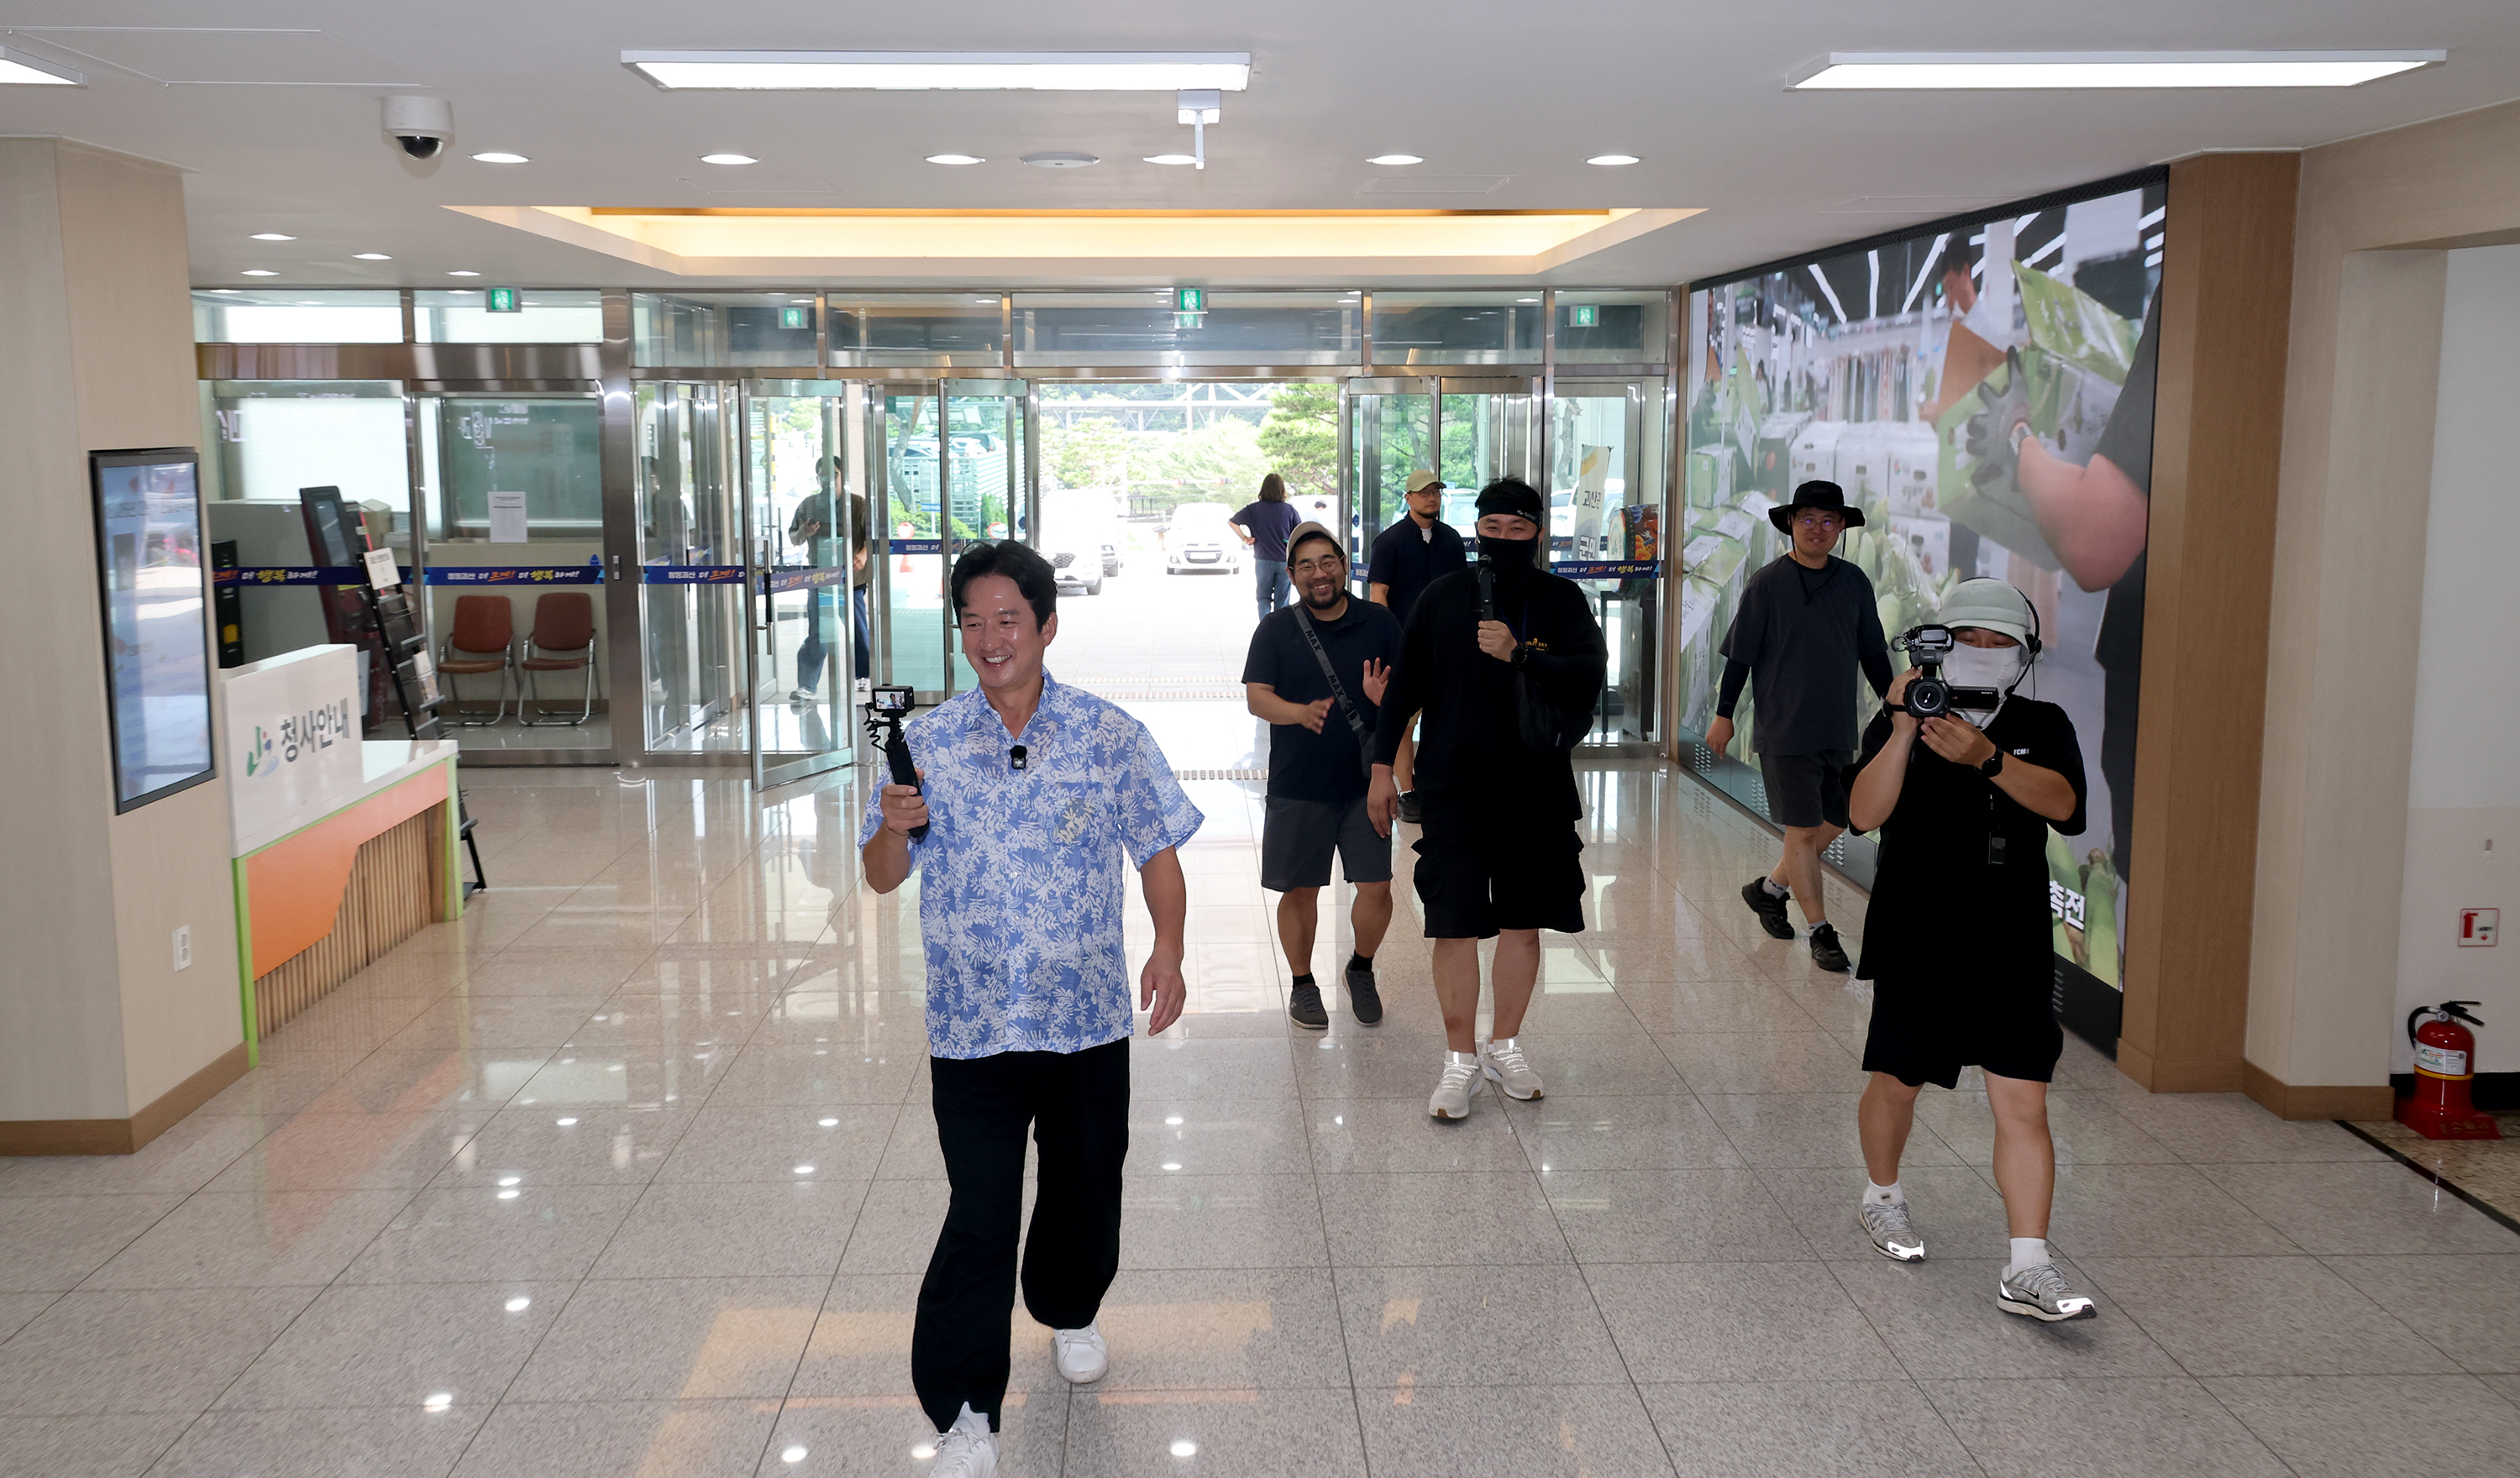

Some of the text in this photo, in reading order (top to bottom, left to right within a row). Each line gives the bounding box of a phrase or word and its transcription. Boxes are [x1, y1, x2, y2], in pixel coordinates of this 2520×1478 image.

[255, 569, 319, 584] 행복하게!
[517, 571, 529, 579] 더
[529, 569, 580, 581] 행복하게!
[1617, 565, 1653, 574] 행복하게!
[1305, 630, 1321, 652] MAX
[1328, 674, 1344, 698] MAX
[280, 697, 350, 763] 청사안내
